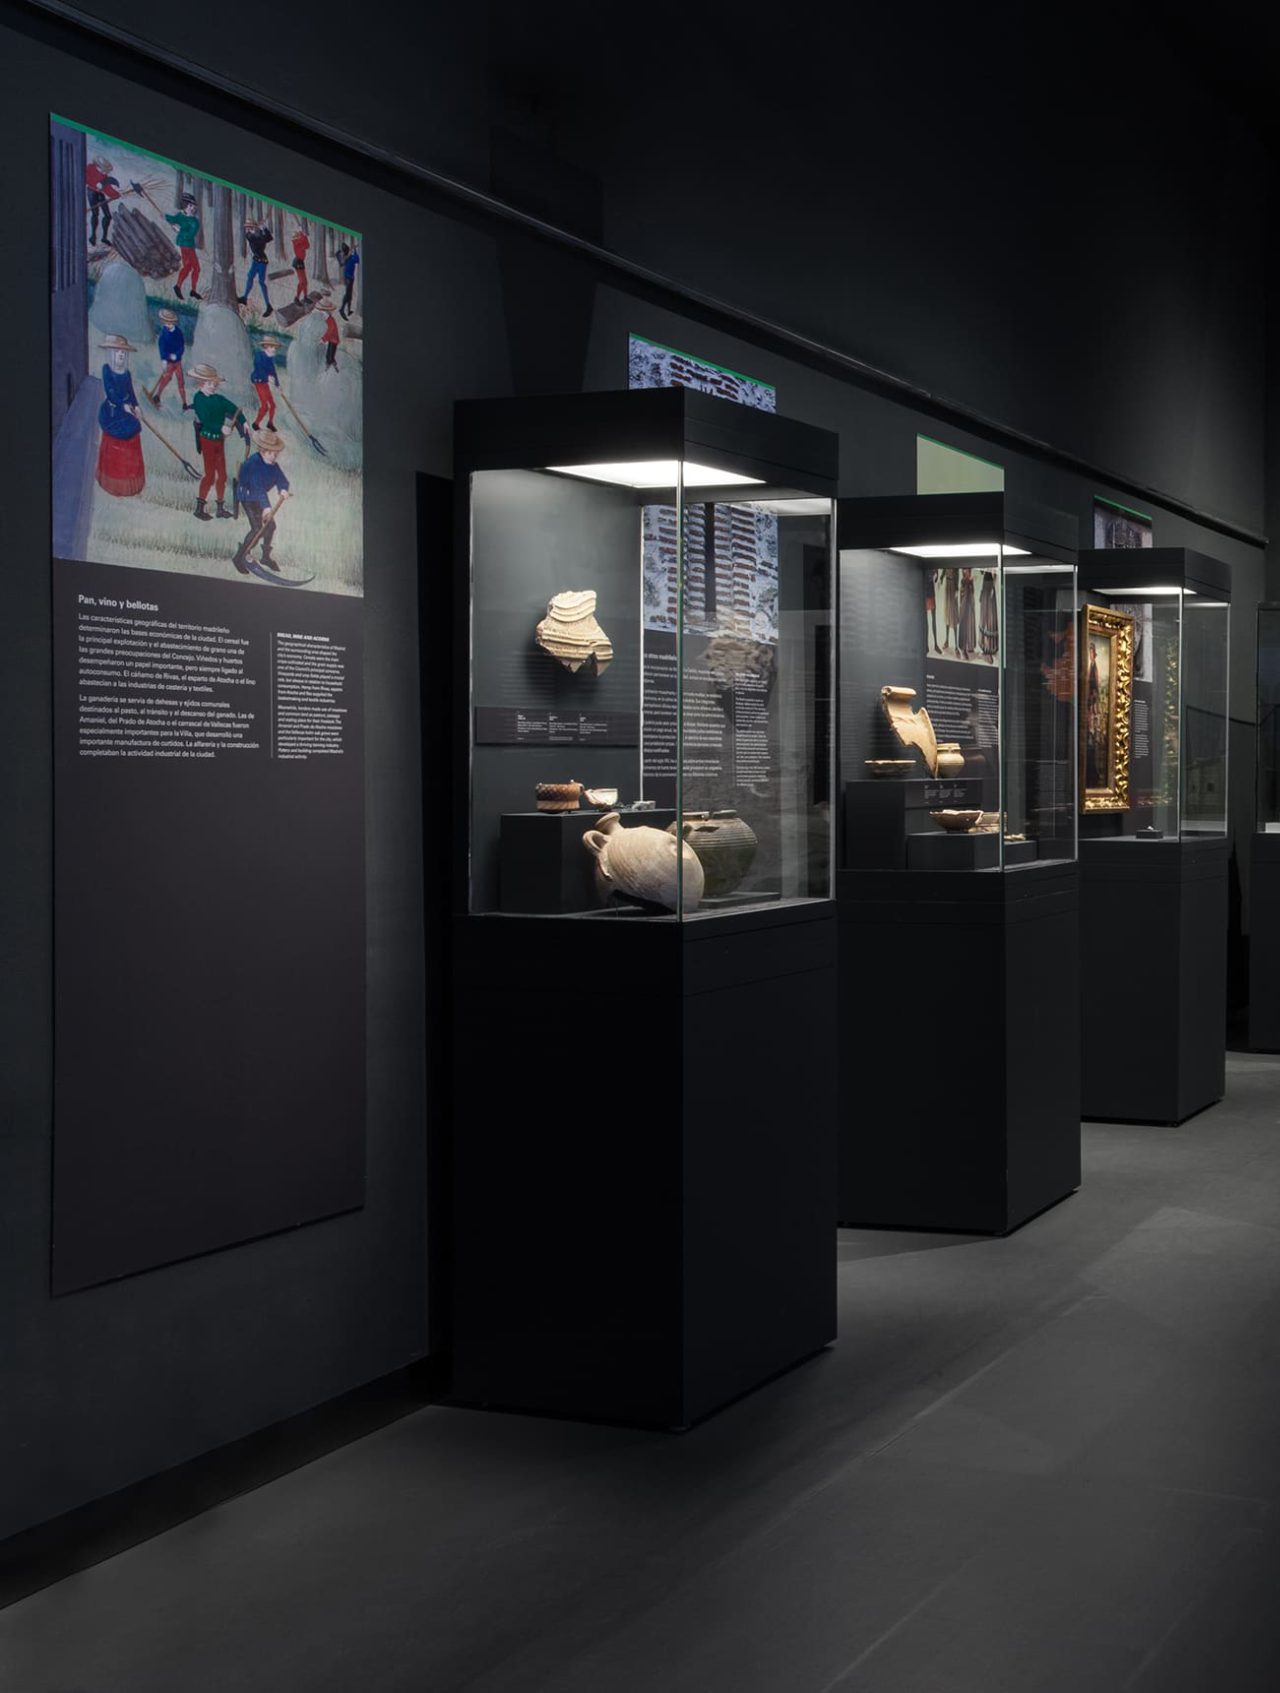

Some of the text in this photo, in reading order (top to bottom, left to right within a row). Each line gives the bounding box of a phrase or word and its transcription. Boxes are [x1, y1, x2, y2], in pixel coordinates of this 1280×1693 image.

[78, 594, 159, 611] Pan, vino y bellotas
